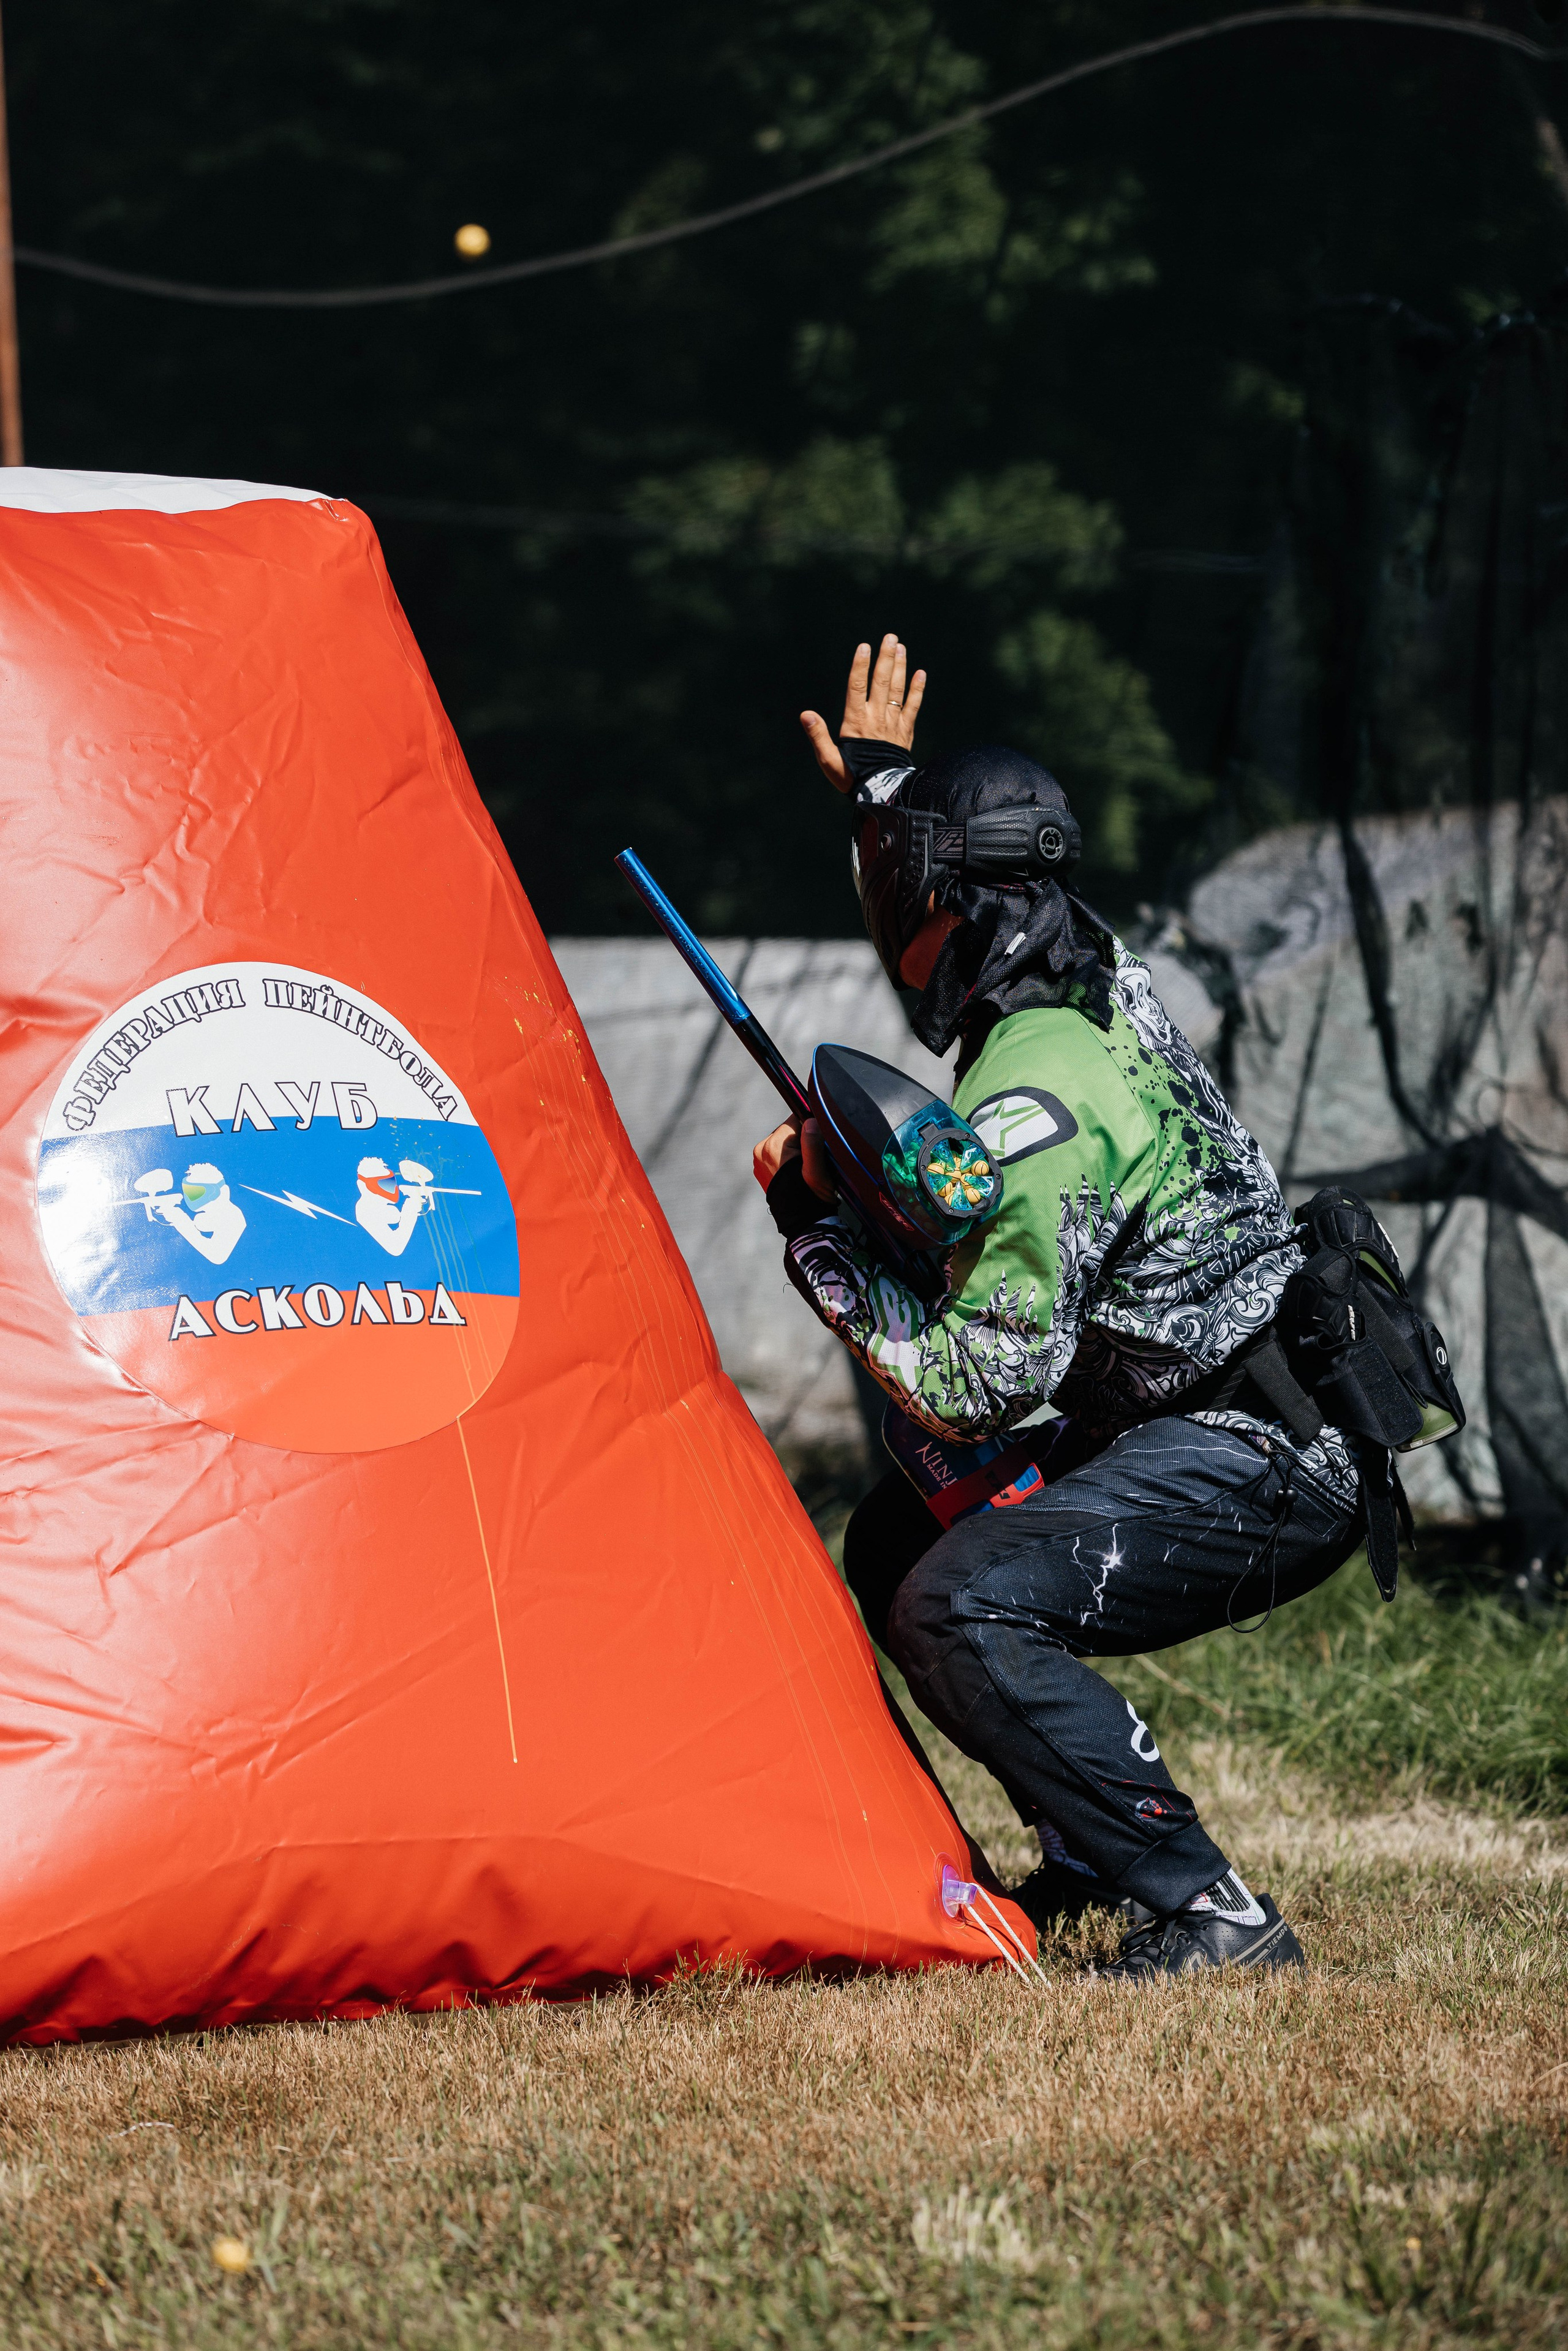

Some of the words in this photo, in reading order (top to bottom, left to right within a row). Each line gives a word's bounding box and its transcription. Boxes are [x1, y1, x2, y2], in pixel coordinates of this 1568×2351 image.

[62, 979, 246, 1131] ФЕДЕРАЦИЯ
[262, 978, 458, 1122] ПЕЙНТБОЛА
[165, 1081, 378, 1137] КЛУБ
[168, 1280, 468, 1342] АСКОЛЬД
[927, 1463, 941, 1482] MADE
[1267, 1925, 1288, 1949] TIEMPO
